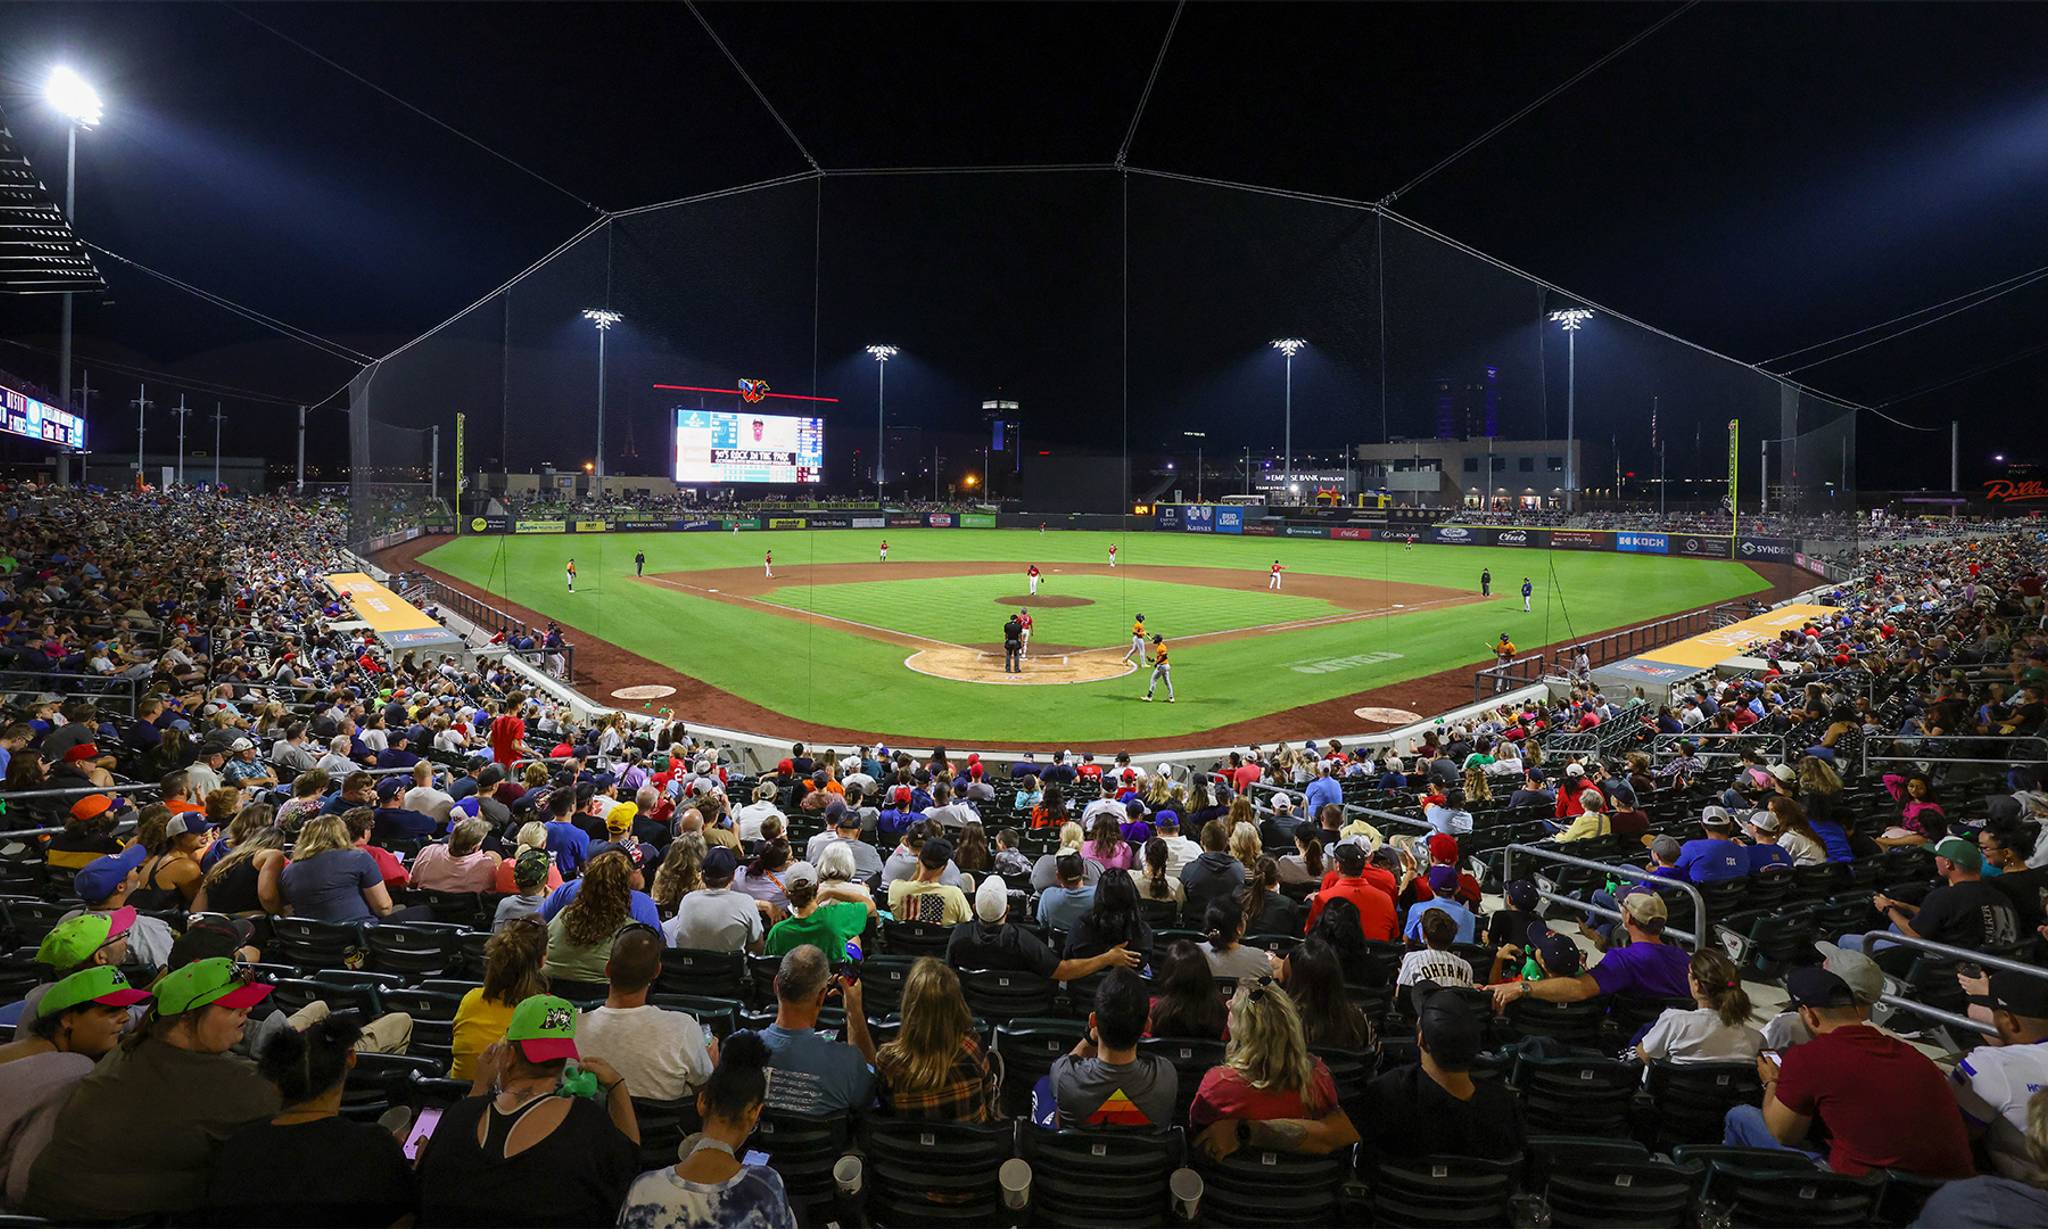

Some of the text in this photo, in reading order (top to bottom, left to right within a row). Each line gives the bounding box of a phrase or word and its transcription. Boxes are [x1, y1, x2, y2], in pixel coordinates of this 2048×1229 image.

[1219, 518, 1239, 526] LIGHT
[1187, 524, 1212, 532] Kansas
[1498, 532, 1527, 542] Club
[1632, 537, 1665, 548] KOCH
[1756, 547, 1792, 556] SYNDEO
[1421, 963, 1468, 984] OHTANI
